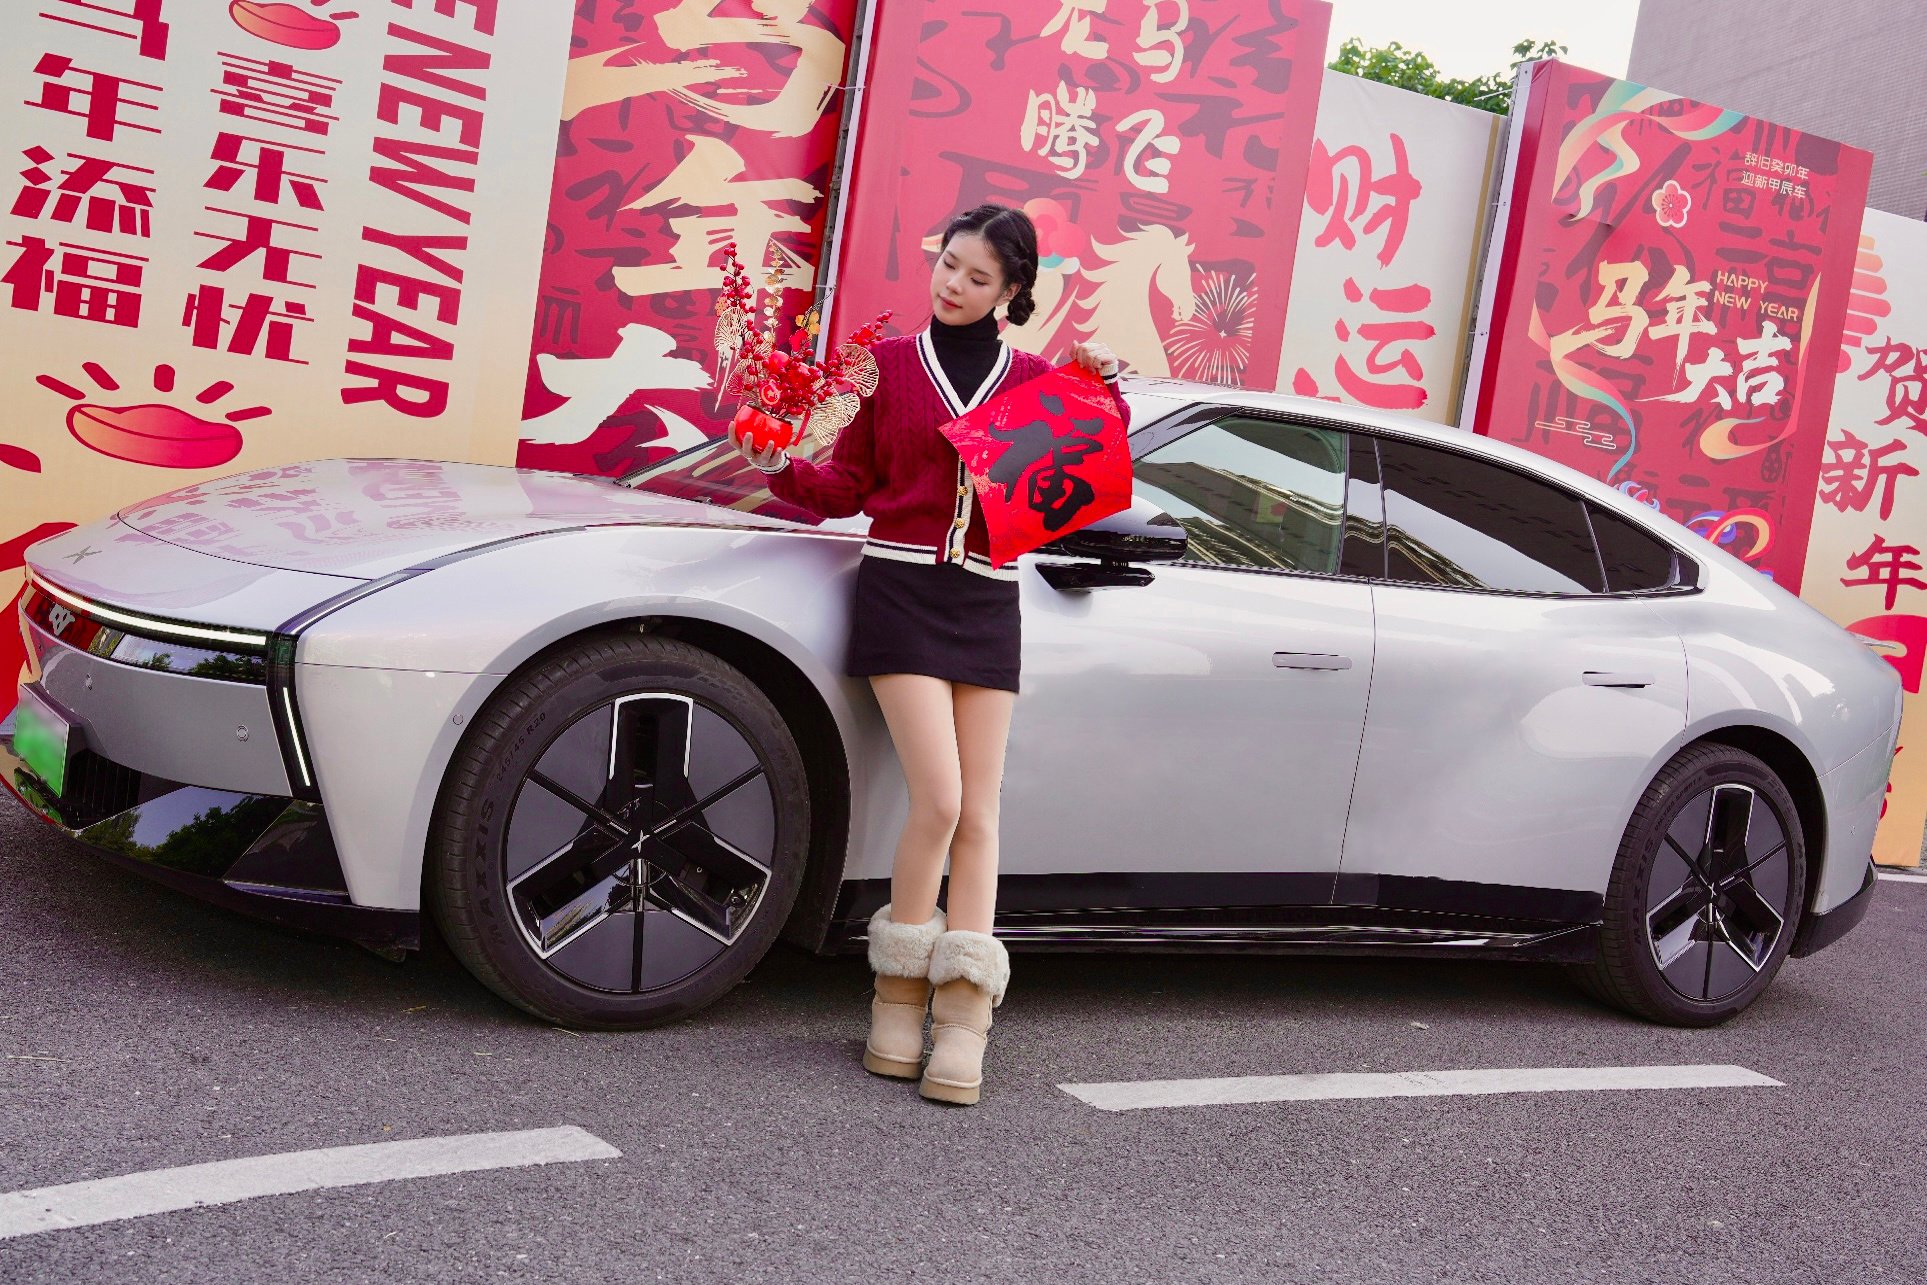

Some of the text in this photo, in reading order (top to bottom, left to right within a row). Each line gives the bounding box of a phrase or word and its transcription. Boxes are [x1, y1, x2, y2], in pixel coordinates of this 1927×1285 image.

[182, 51, 343, 364] 喜乐无忧
[1744, 152, 1810, 180] 辞旧癸卯年
[1293, 133, 1436, 409] 财运
[1713, 290, 1799, 321] NEW YEAR
[1716, 270, 1769, 293] HAPPY
[988, 390, 1104, 532] 福
[1818, 335, 1927, 611] 贺新年
